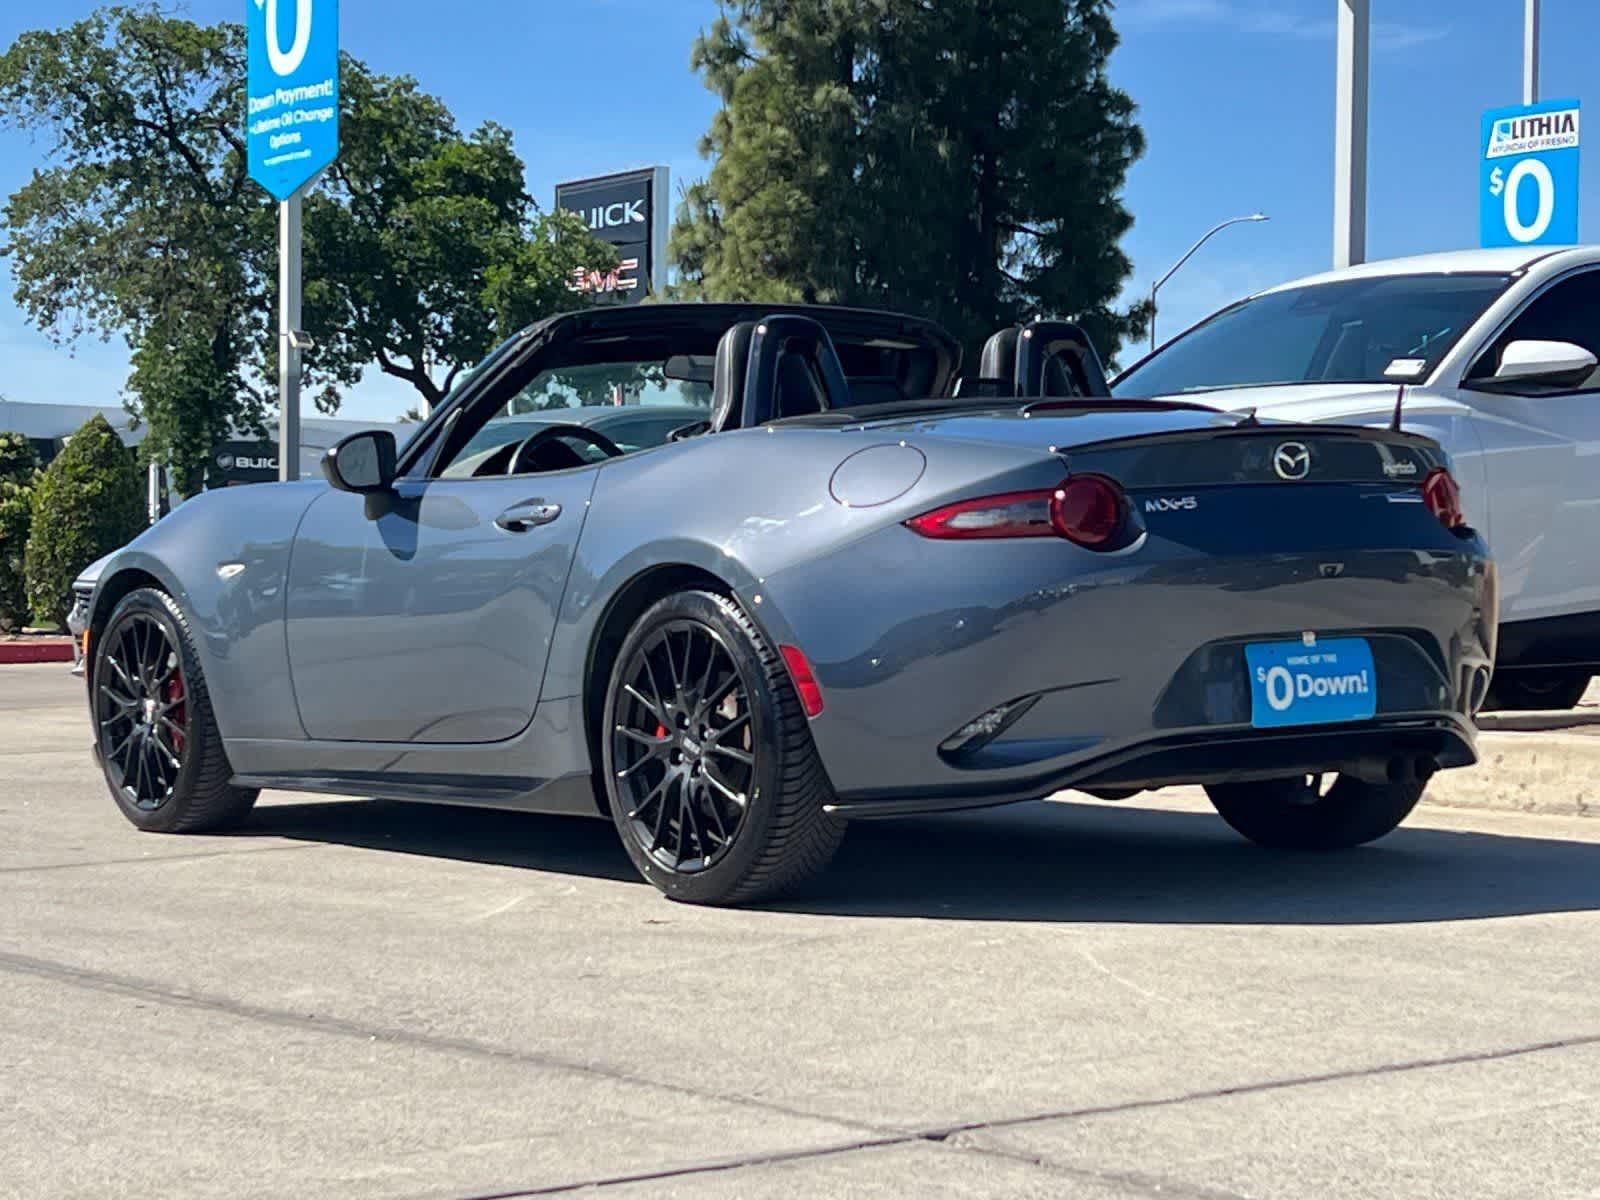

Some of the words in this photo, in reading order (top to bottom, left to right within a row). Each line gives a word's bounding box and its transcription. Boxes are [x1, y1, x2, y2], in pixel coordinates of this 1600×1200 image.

[248, 94, 274, 114] Down
[275, 79, 334, 107] Payment!
[281, 111, 293, 127] Oil
[293, 107, 334, 123] Change
[1512, 113, 1575, 139] LITHIA
[269, 132, 302, 149] Options
[1528, 140, 1538, 149] OF
[1541, 136, 1576, 146] FRESNO
[1489, 158, 1554, 242] $0
[574, 199, 646, 230] UICK
[235, 456, 280, 469] BUIC
[1145, 495, 1198, 513] MX-5
[1296, 669, 1369, 698] Down!
